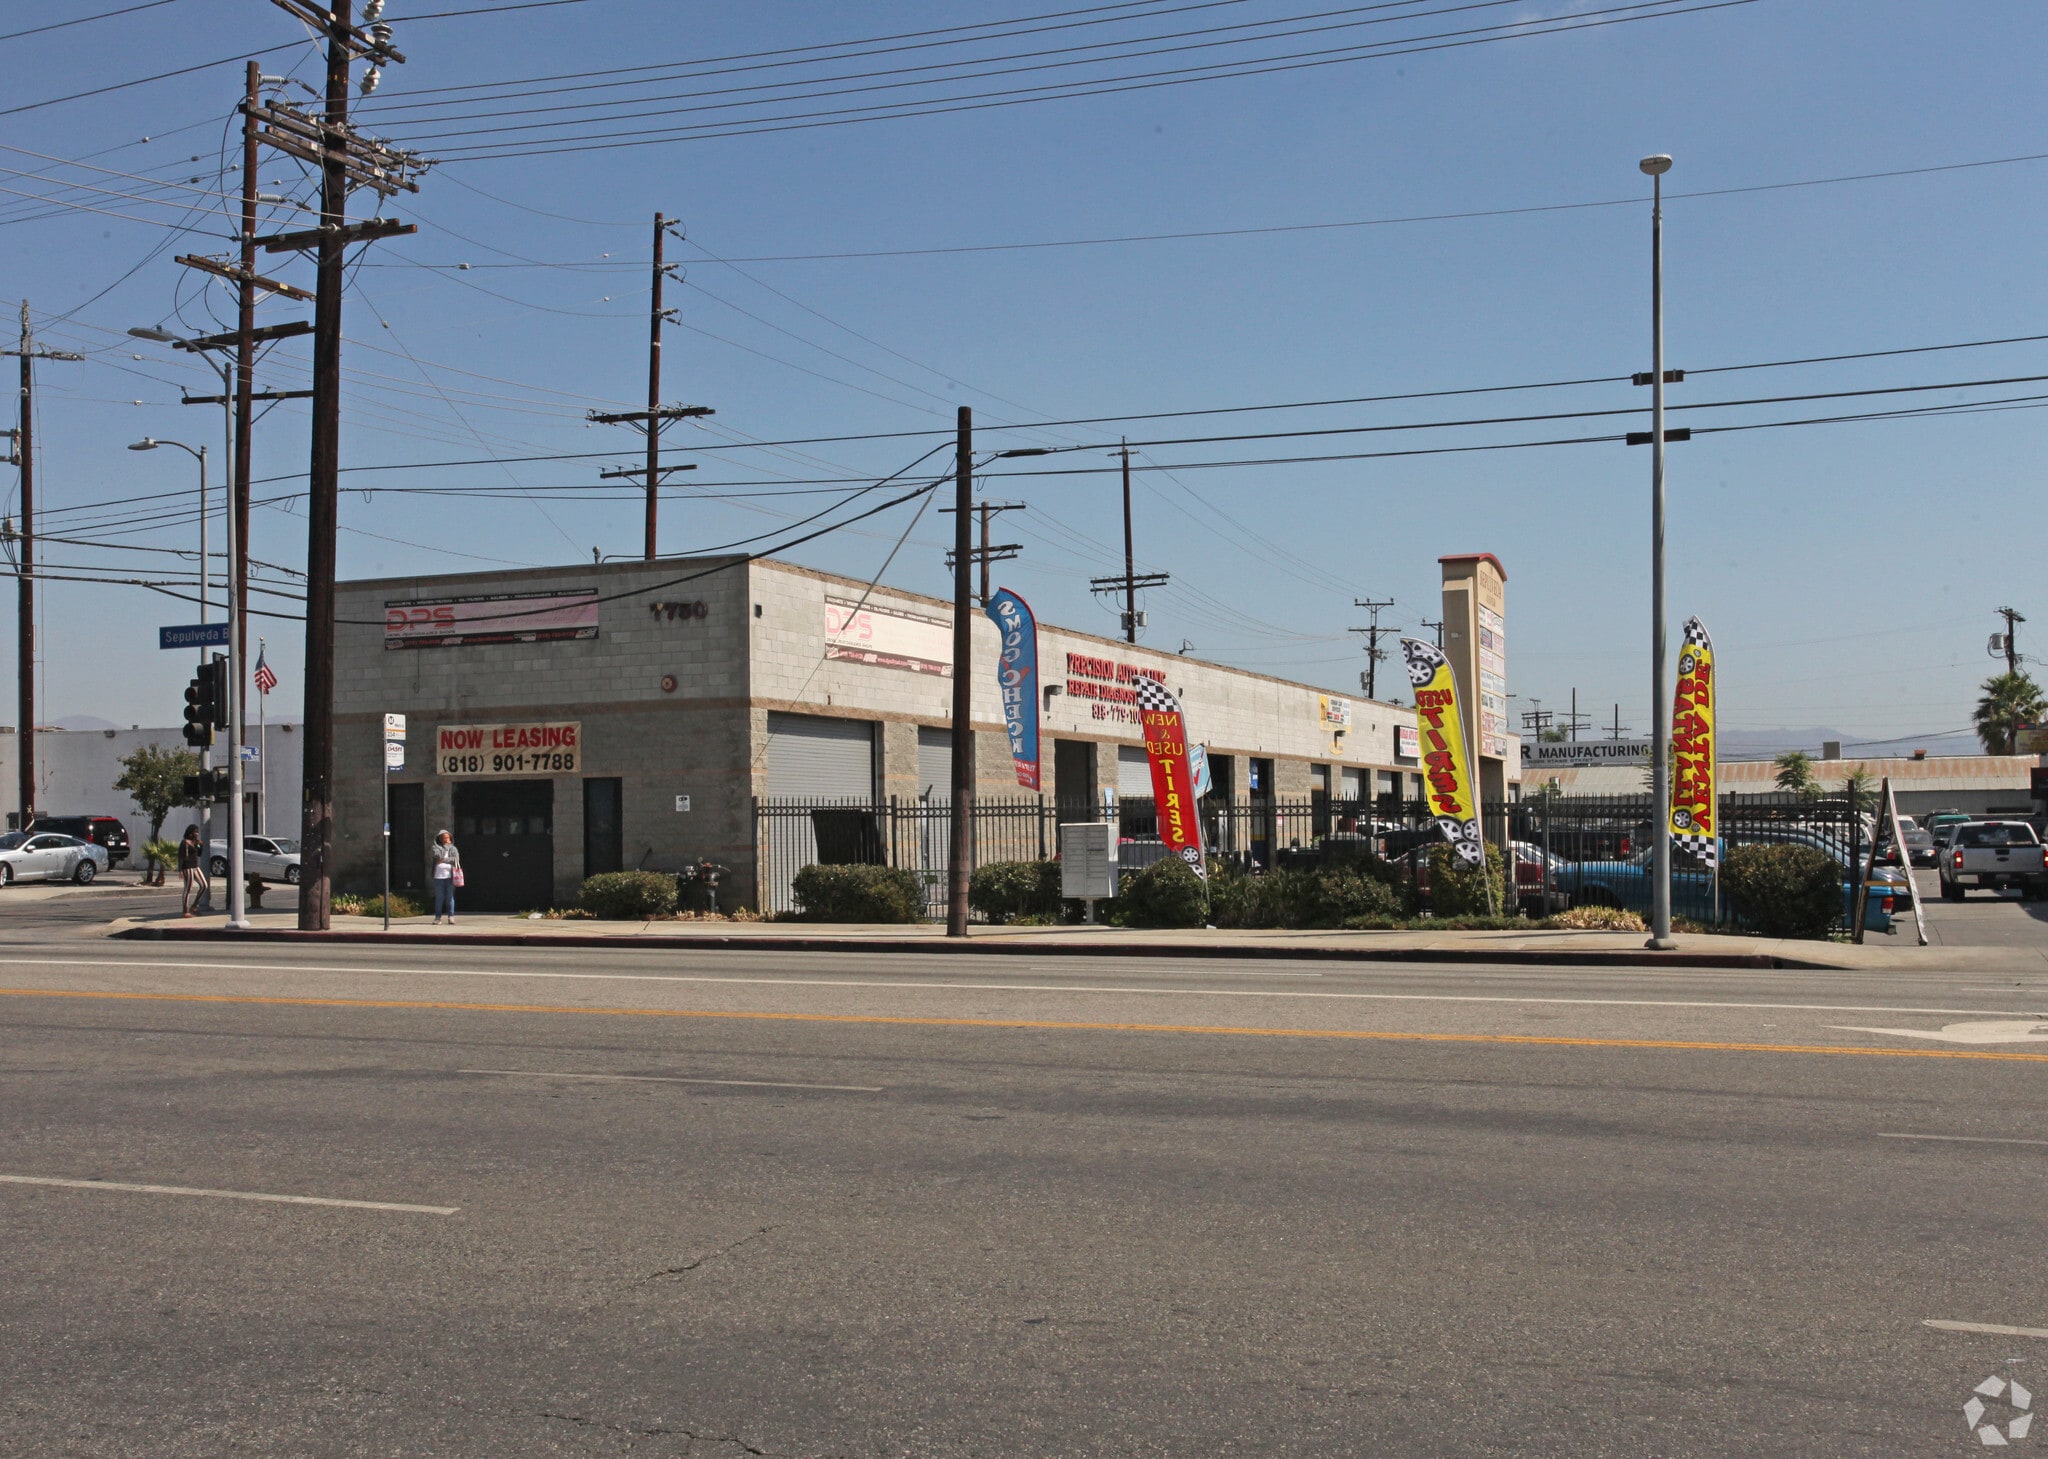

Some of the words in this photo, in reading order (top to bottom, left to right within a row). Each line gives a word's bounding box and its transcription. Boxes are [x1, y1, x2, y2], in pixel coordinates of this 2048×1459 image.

[387, 606, 456, 631] DPS
[826, 607, 873, 640] DPS
[165, 629, 218, 643] Sepulveda
[1066, 652, 1114, 681] PRECISION
[1116, 663, 1139, 685] AUTO
[1066, 679, 1098, 700] REPAIR
[1099, 685, 1138, 706] DIAGNOST
[440, 730, 484, 749] NOW
[493, 726, 576, 748] LEASING
[442, 755, 484, 773] (818)
[493, 753, 574, 771] 901-7788
[1538, 743, 1649, 759] MANUFACTURING
